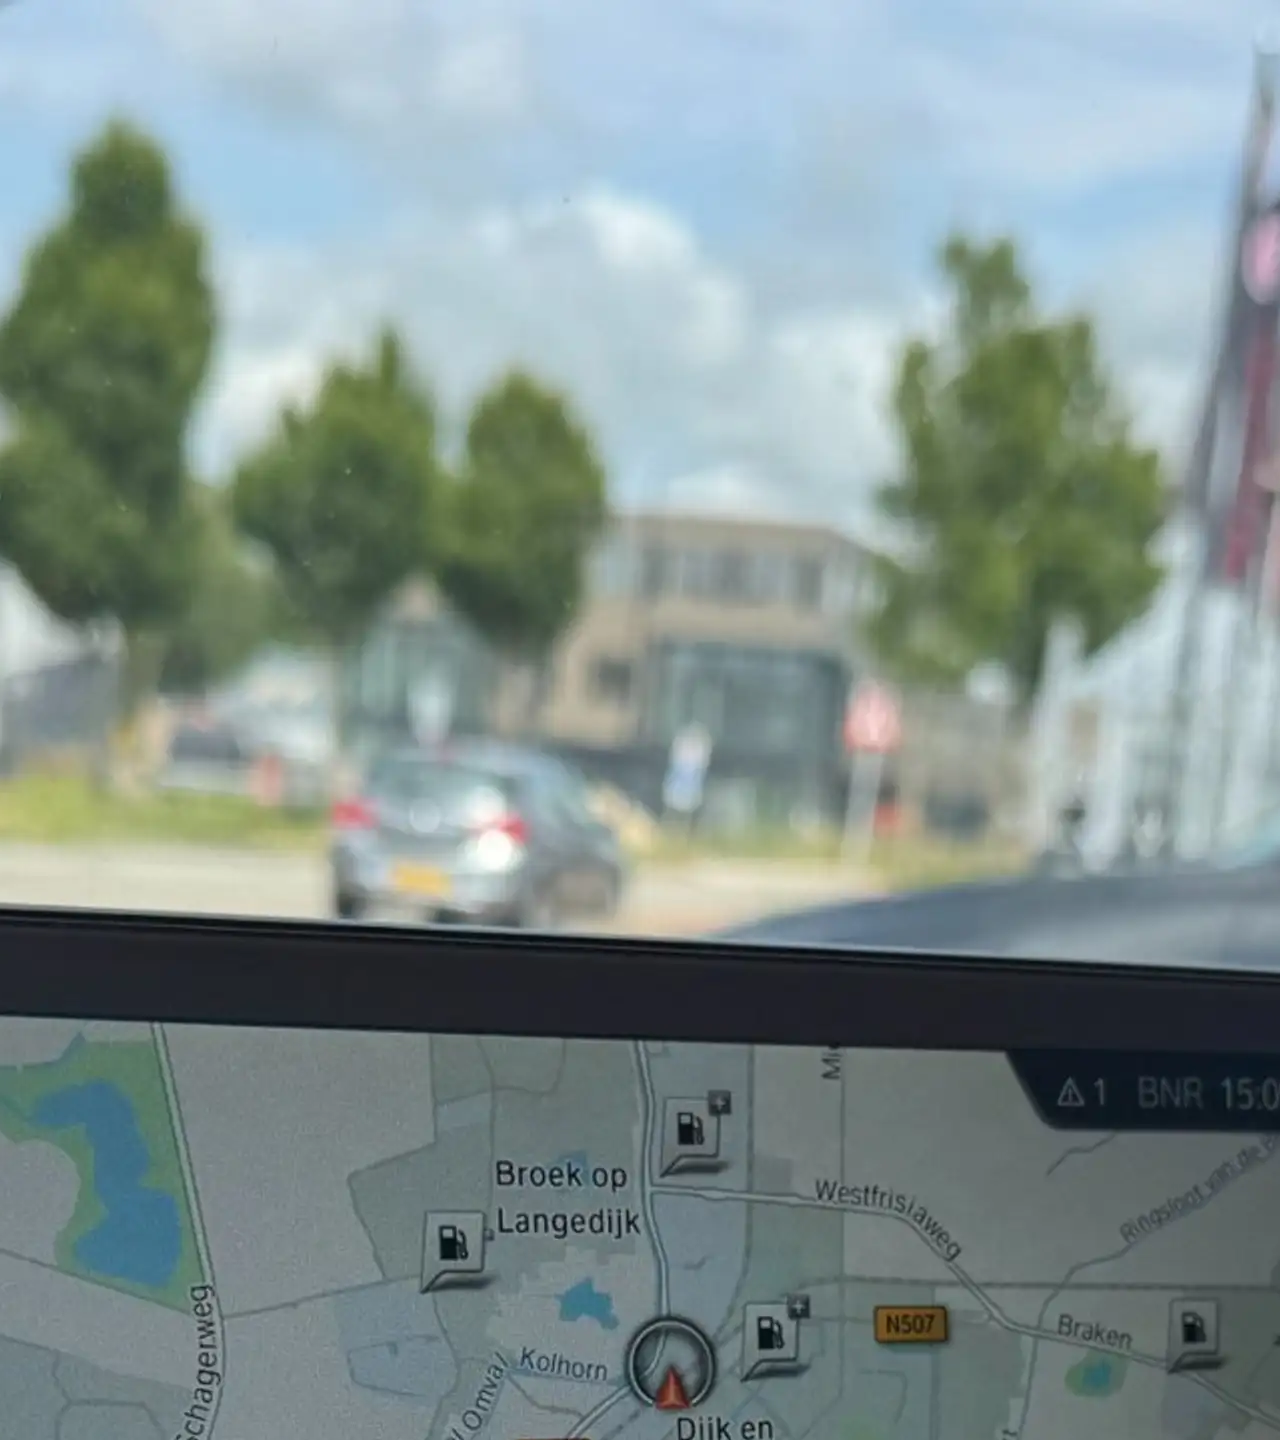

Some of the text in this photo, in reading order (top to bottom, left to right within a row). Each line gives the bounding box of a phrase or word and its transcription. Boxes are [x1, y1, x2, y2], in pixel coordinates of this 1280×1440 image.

[1093, 1078, 1106, 1105] 1
[1138, 1077, 1204, 1109] BNR
[496, 1161, 627, 1194] Broek op
[497, 1208, 641, 1240] Langedijk
[815, 1179, 963, 1262] Westfrisiaweg
[886, 1314, 935, 1334] N507
[1058, 1315, 1132, 1350] Braken
[519, 1346, 609, 1383] Kolhorn
[462, 1350, 511, 1432] Omval
[742, 1422, 774, 1440] en
